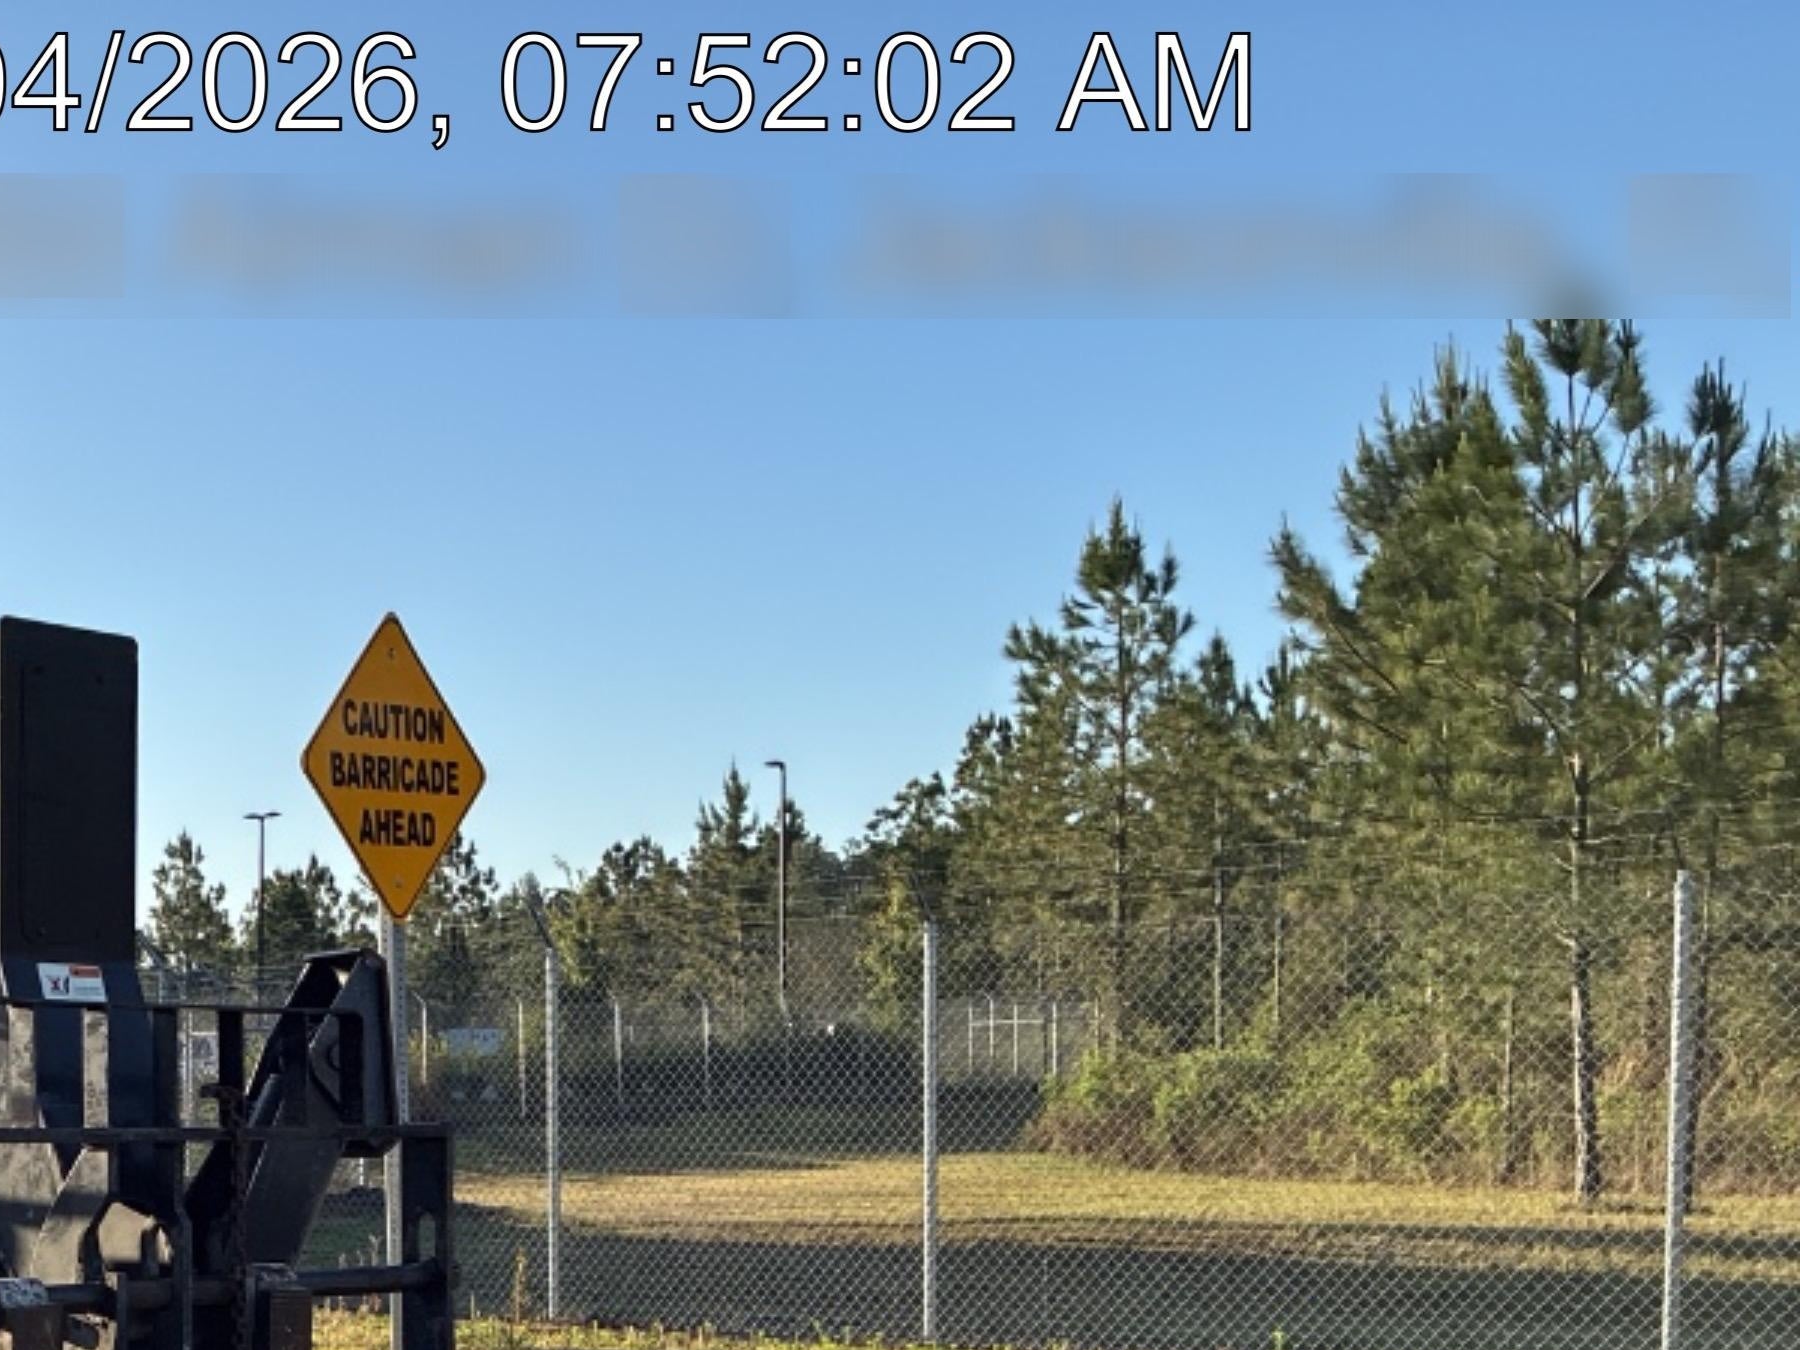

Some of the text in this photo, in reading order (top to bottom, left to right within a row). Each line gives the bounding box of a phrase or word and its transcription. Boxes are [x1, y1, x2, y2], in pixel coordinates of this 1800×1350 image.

[342, 699, 446, 744] CAUTION
[330, 752, 460, 796] BARRICADE
[359, 808, 436, 847] AHEAD
